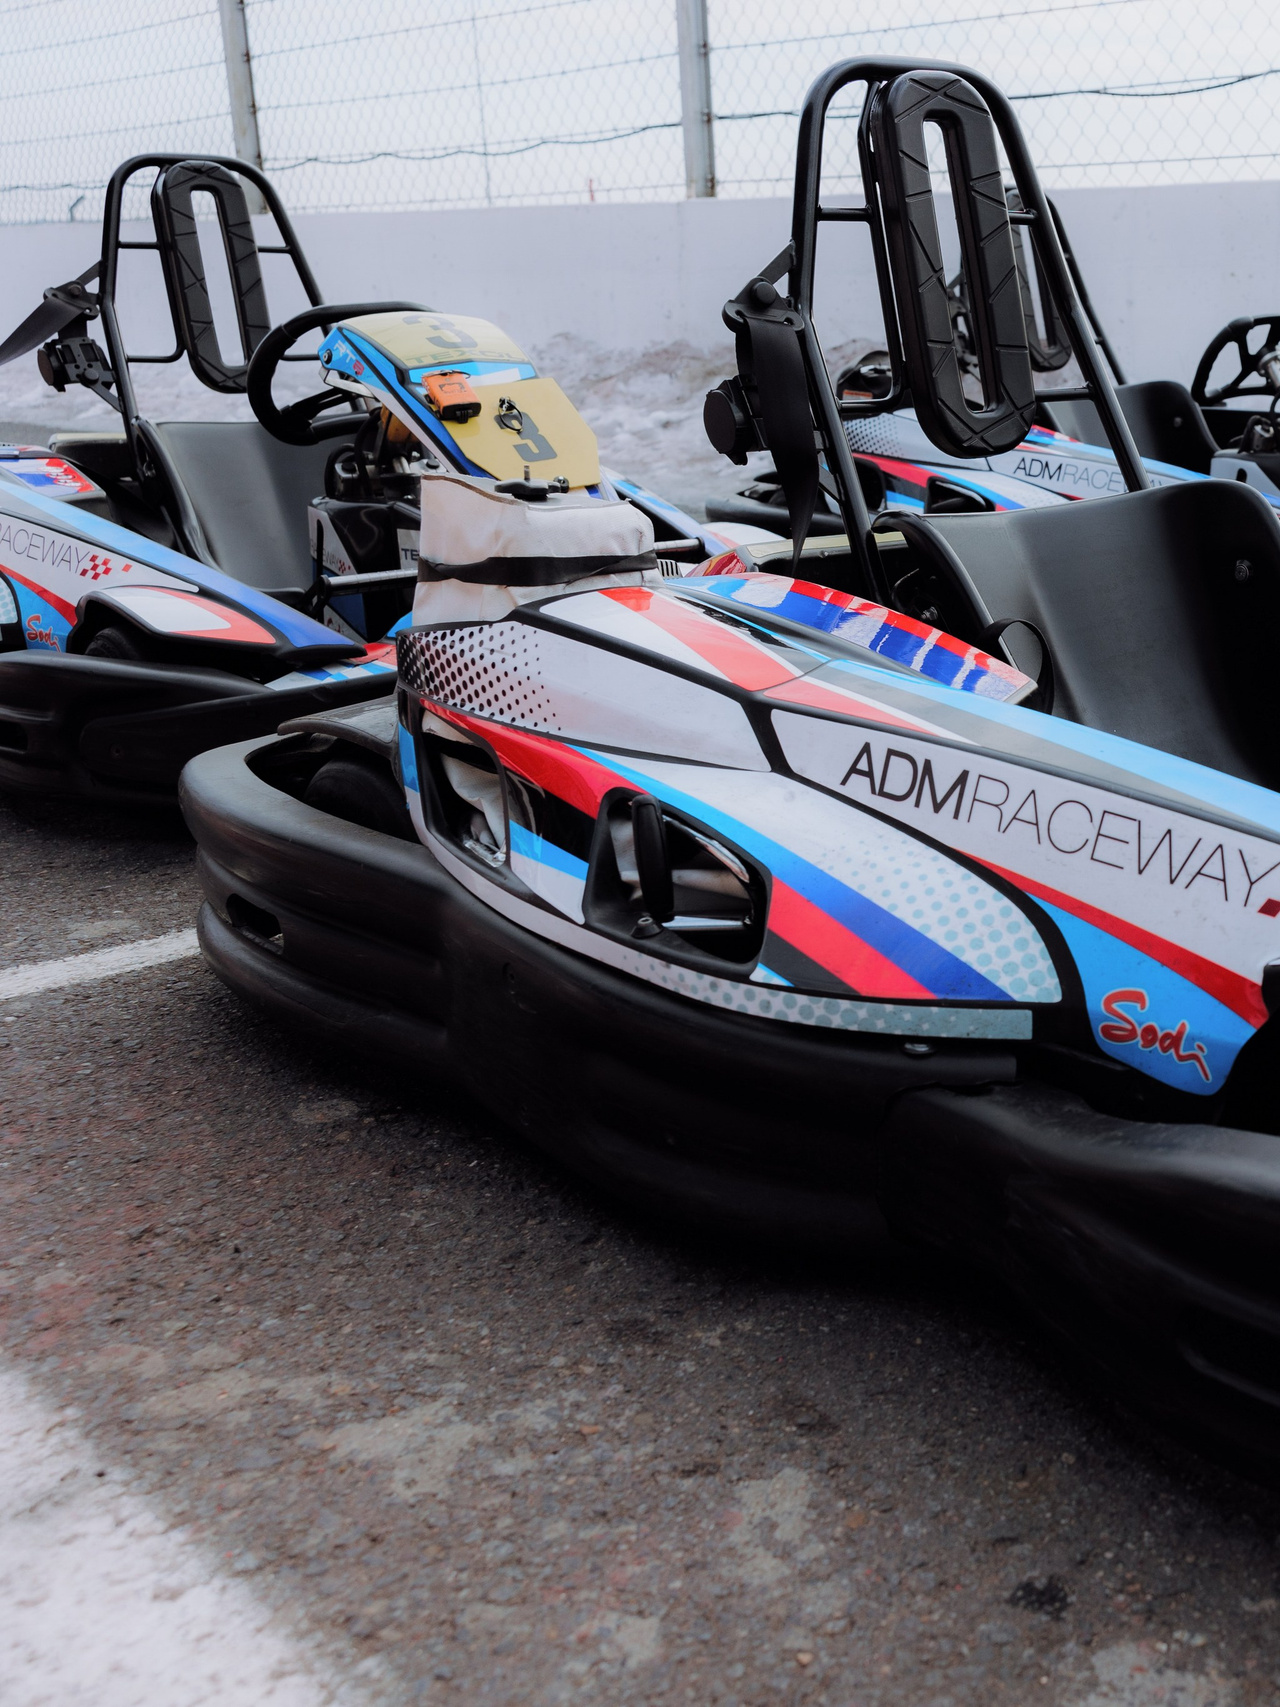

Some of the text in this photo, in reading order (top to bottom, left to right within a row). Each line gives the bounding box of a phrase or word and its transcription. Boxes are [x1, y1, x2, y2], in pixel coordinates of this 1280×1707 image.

[402, 315, 478, 349] 3
[494, 411, 557, 462] 3
[0, 523, 90, 573] ACEWAY
[27, 614, 61, 652] Sodi
[1099, 987, 1212, 1083] Sodi
